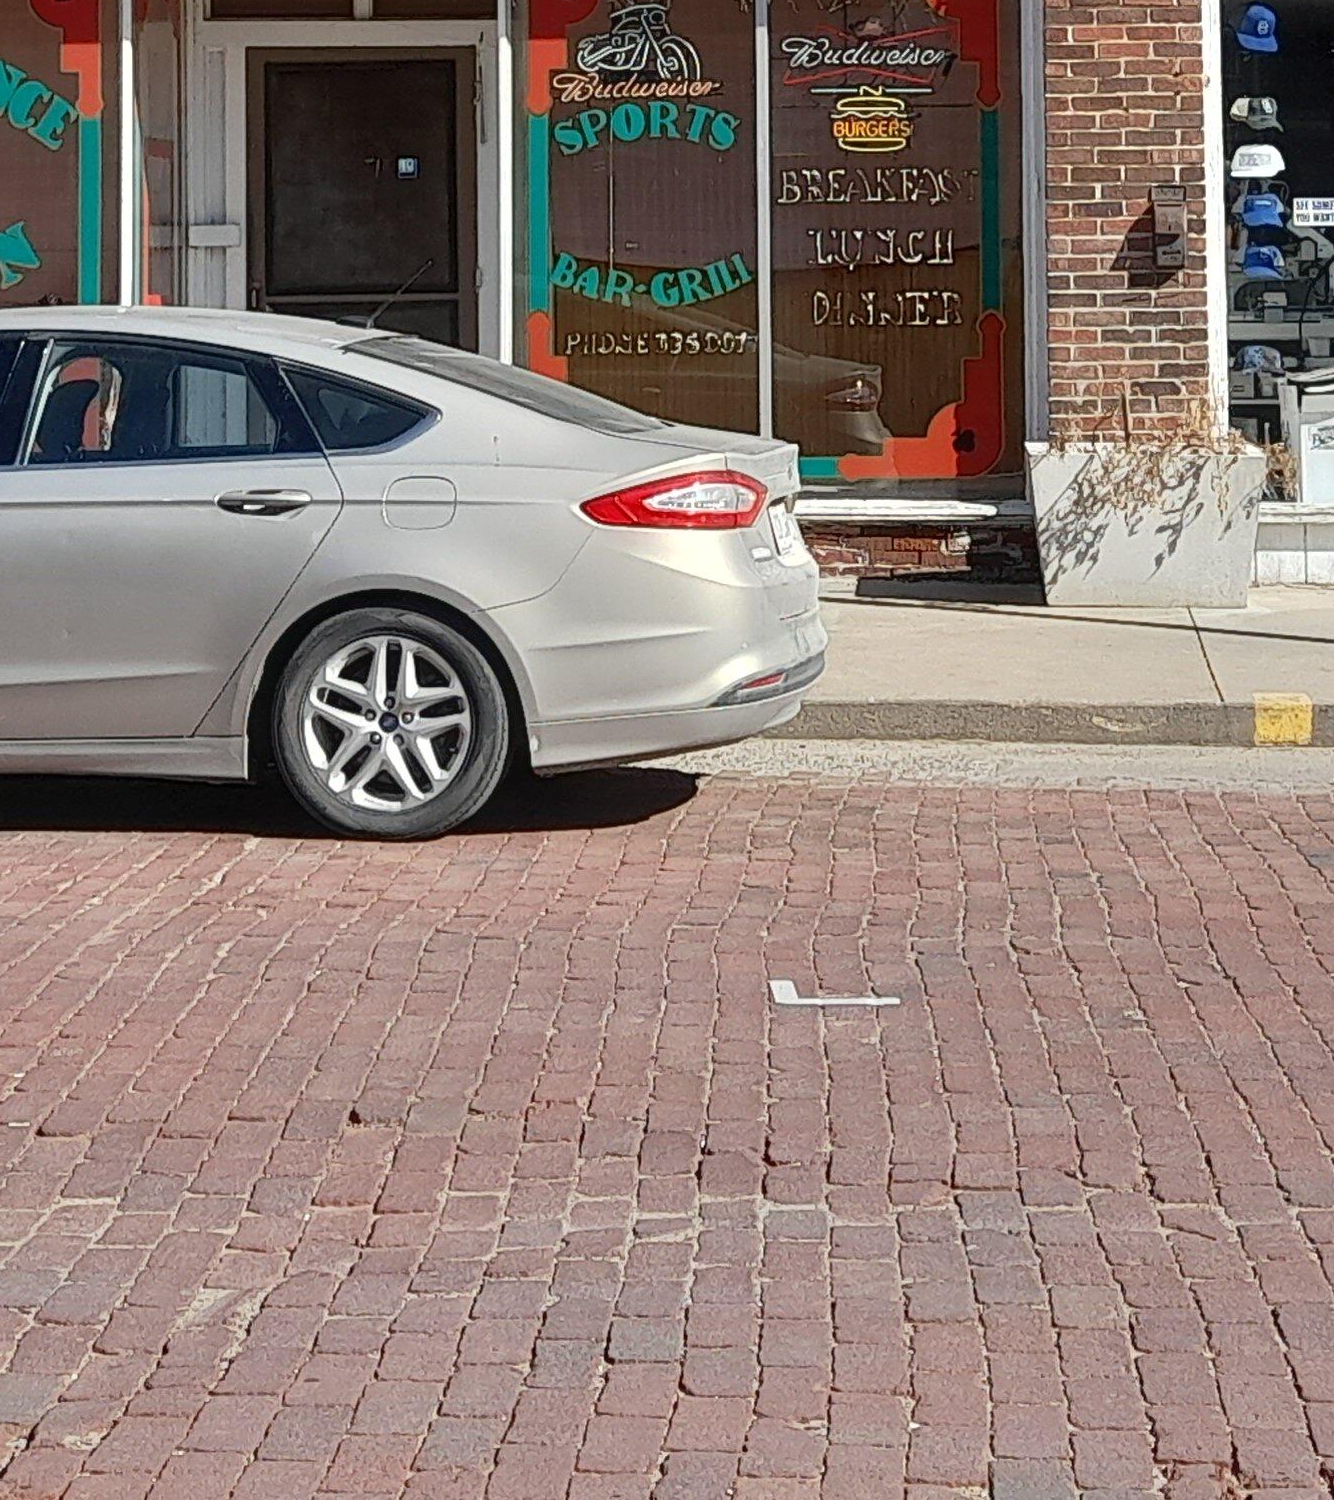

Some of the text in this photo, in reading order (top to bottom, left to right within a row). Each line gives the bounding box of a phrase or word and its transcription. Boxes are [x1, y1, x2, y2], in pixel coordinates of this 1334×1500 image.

[781, 36, 953, 68] Budweiser
[552, 72, 722, 103] Budweiser
[553, 100, 741, 156] SPORTS
[832, 119, 912, 138] BURGERS
[807, 229, 955, 268] LUNCH
[812, 291, 964, 327] DINNER
[565, 332, 649, 355] PHONE
